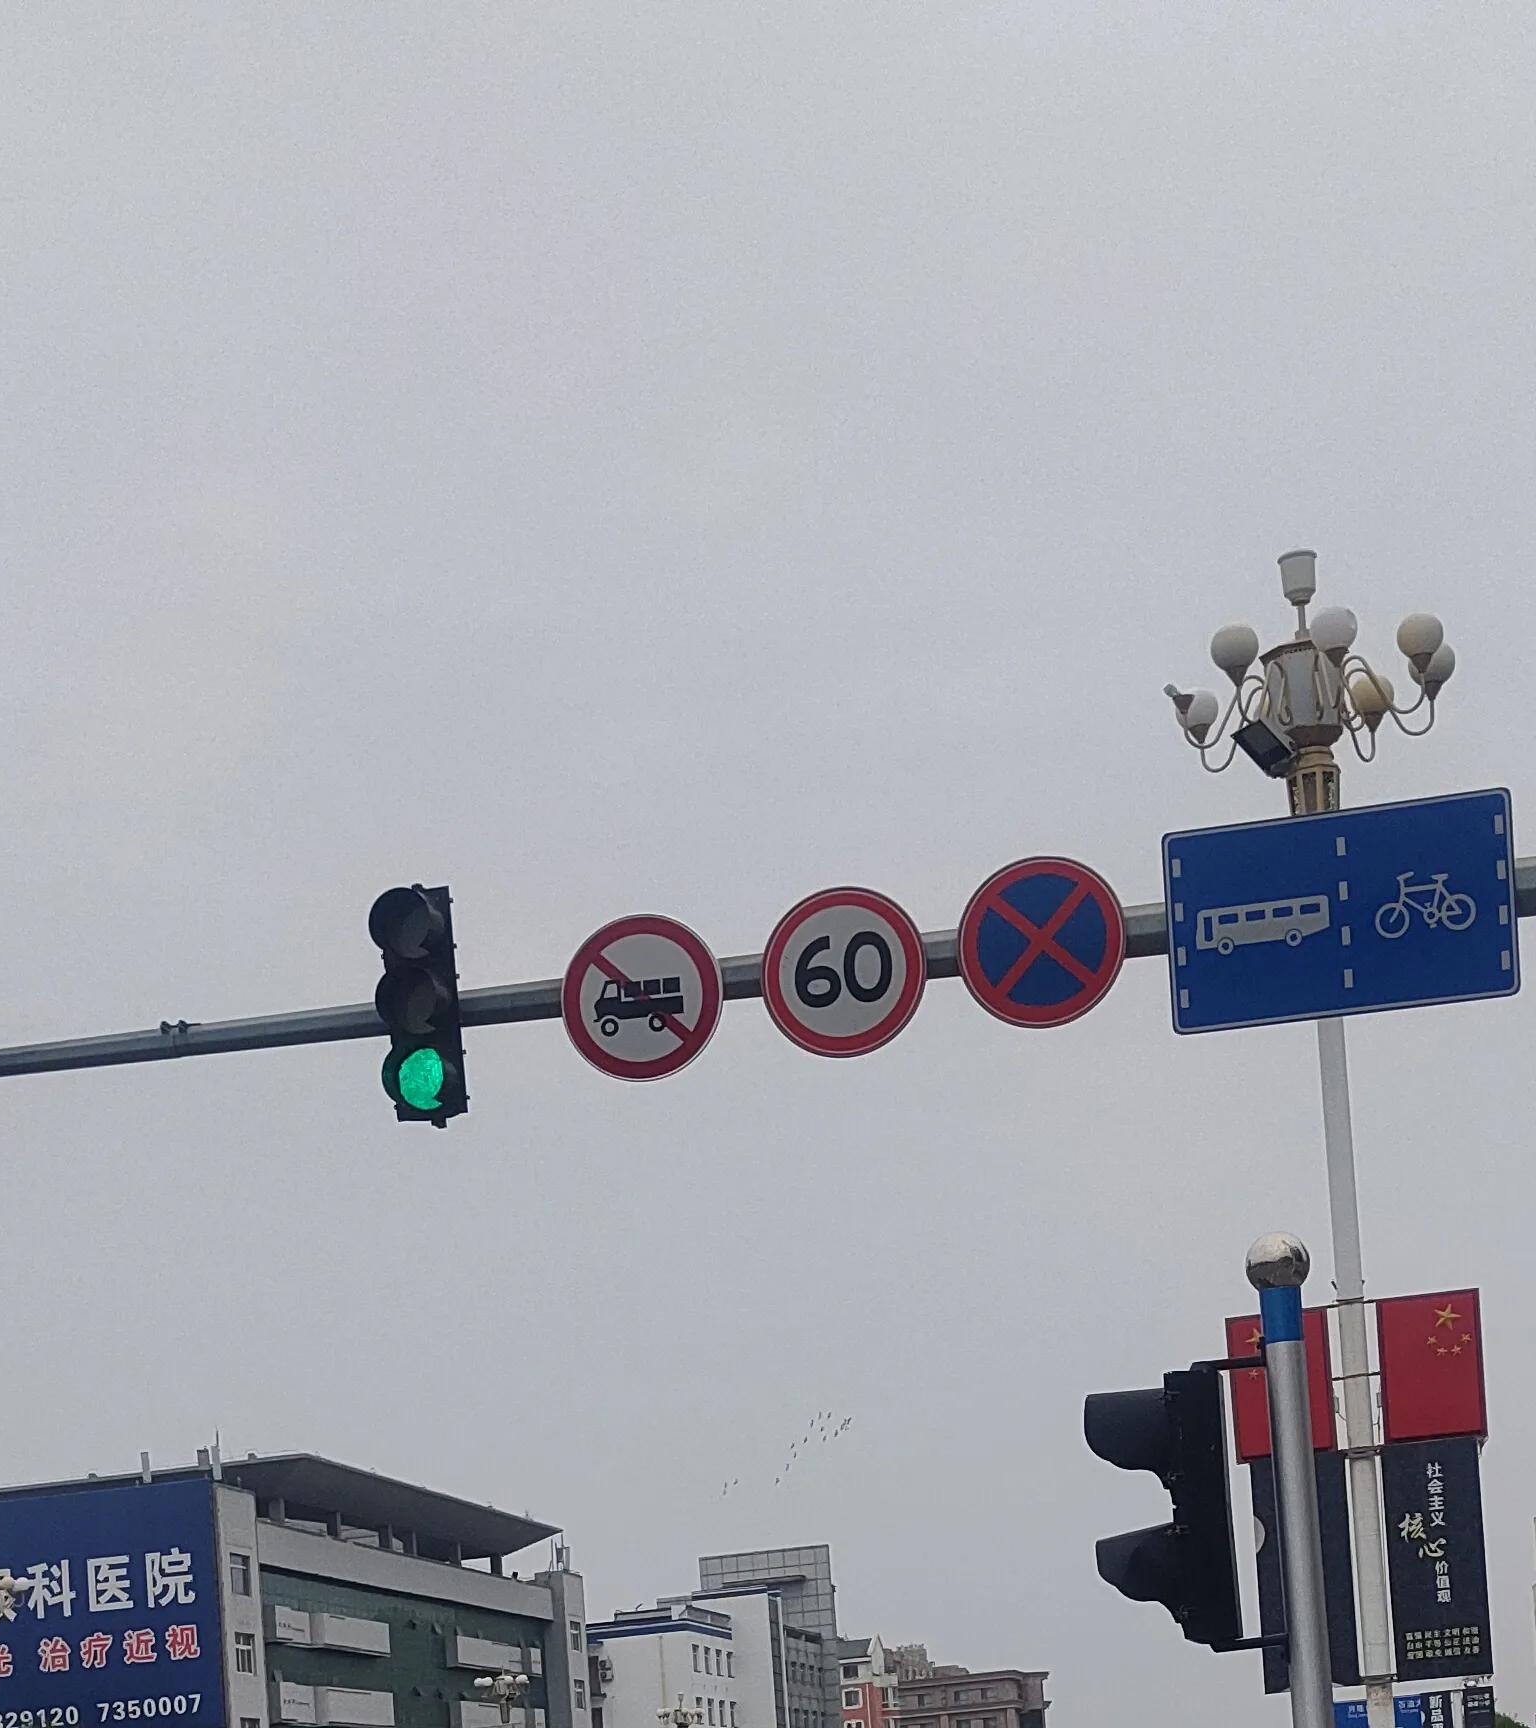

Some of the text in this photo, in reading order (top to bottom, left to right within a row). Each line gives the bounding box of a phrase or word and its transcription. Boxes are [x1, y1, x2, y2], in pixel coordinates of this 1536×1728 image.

[794, 930, 893, 1008] 60
[1426, 1462, 1446, 1527] 社会主义
[1398, 1512, 1447, 1560] 核心
[1434, 1560, 1452, 1603] 价值观
[37, 1624, 201, 1674] 治疗近视
[95, 1693, 202, 1723] 7350007
